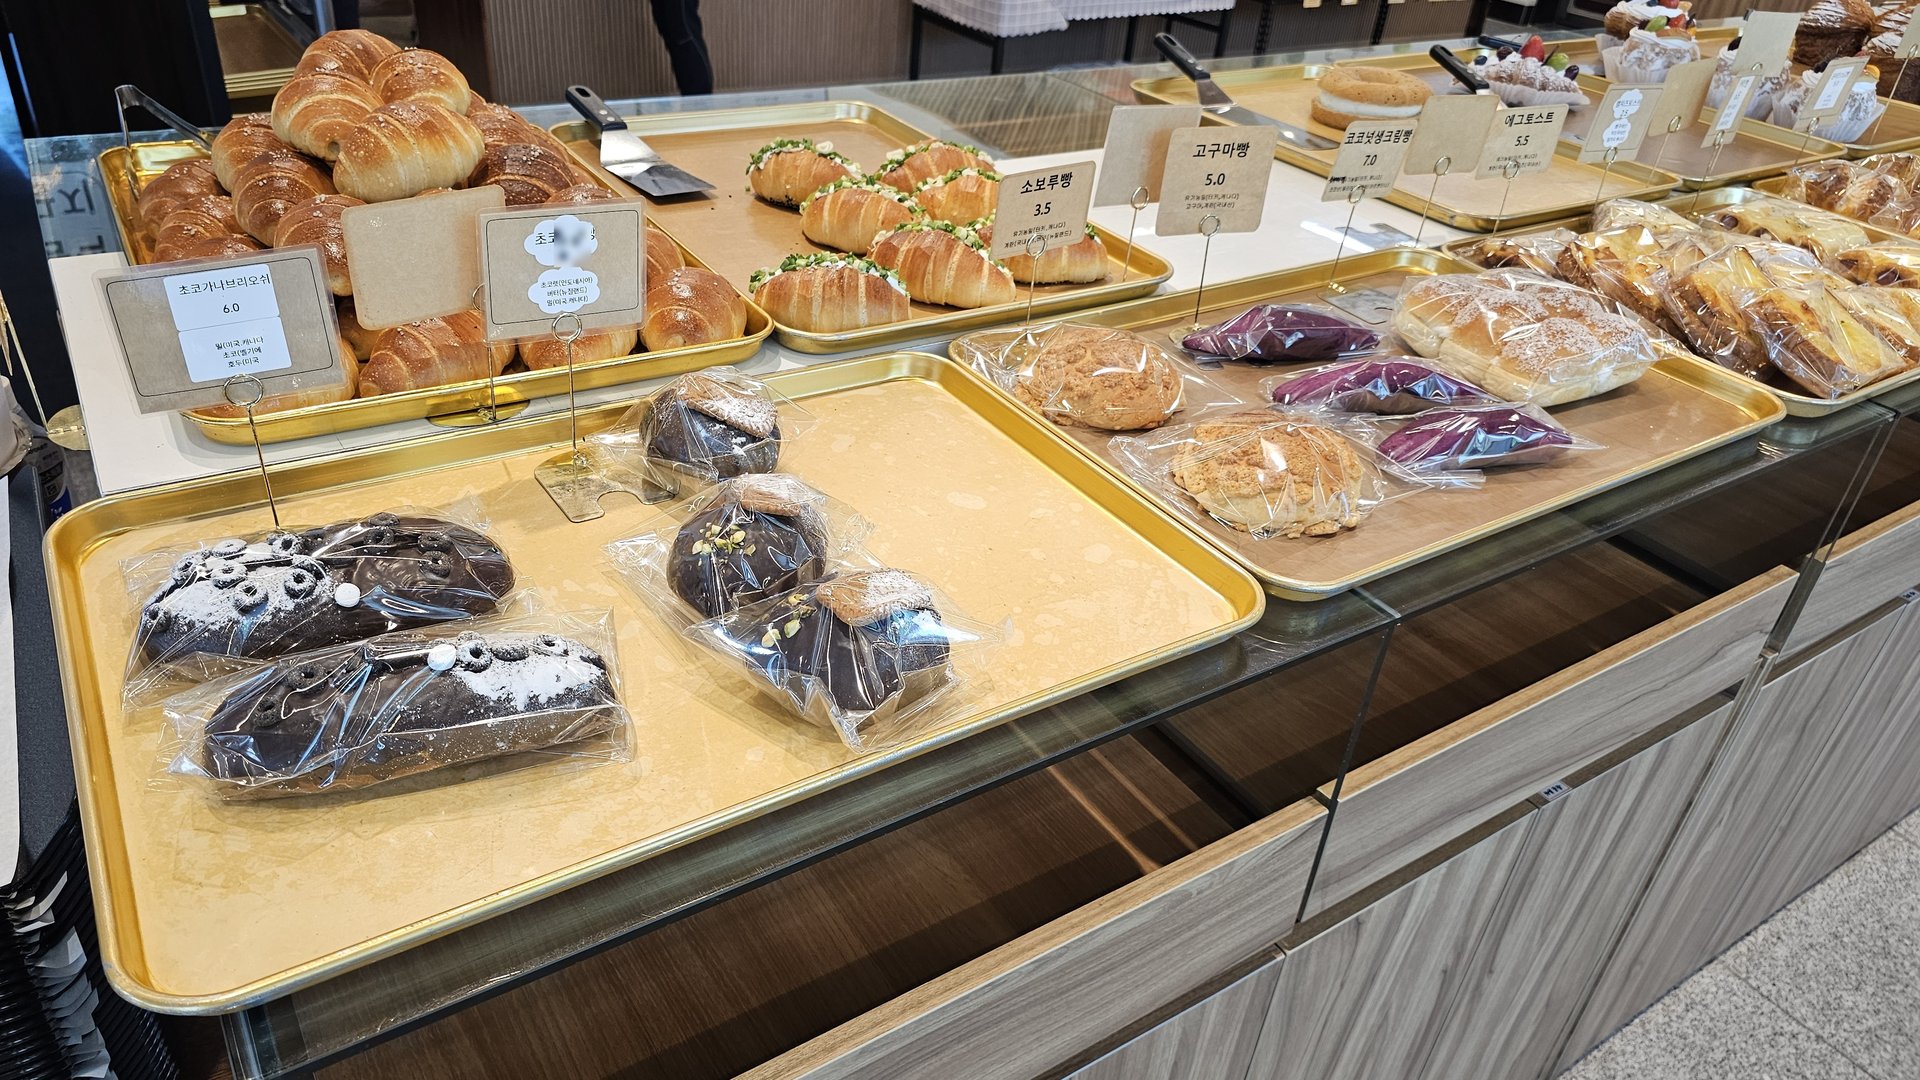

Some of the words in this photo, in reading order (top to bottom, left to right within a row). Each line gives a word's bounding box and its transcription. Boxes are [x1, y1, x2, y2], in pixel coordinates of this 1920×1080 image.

[1504, 112, 1554, 127] 에그토스트
[1344, 129, 1413, 145] 코코넛생크림빵
[1515, 135, 1530, 146] 5.5
[1193, 142, 1250, 159] 고구마빵
[1363, 154, 1378, 166] 7.0
[1020, 171, 1073, 194] 소보루빵
[1205, 173, 1226, 186] 5.0
[1034, 202, 1051, 216] 3.5
[179, 273, 271, 295] 초코가나브리오쉬
[223, 303, 240, 313] 6.0
